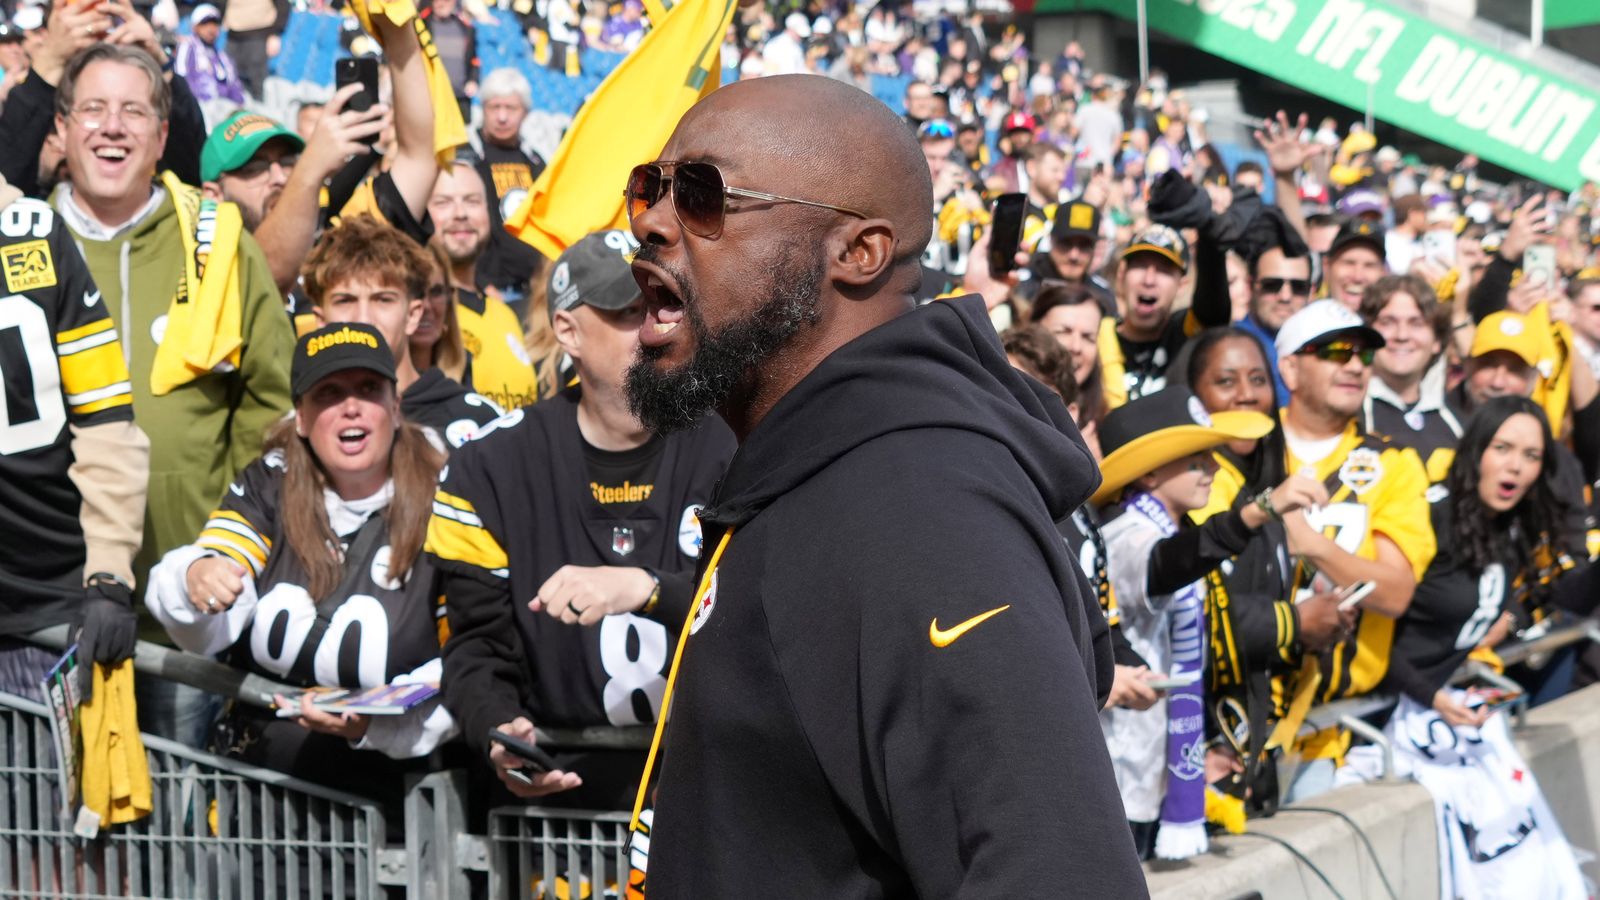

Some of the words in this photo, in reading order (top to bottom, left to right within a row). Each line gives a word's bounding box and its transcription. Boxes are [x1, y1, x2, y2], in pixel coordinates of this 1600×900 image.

[1296, 0, 1406, 83] NFL
[1395, 34, 1597, 163] DUBLIN
[307, 327, 378, 357] Steelers
